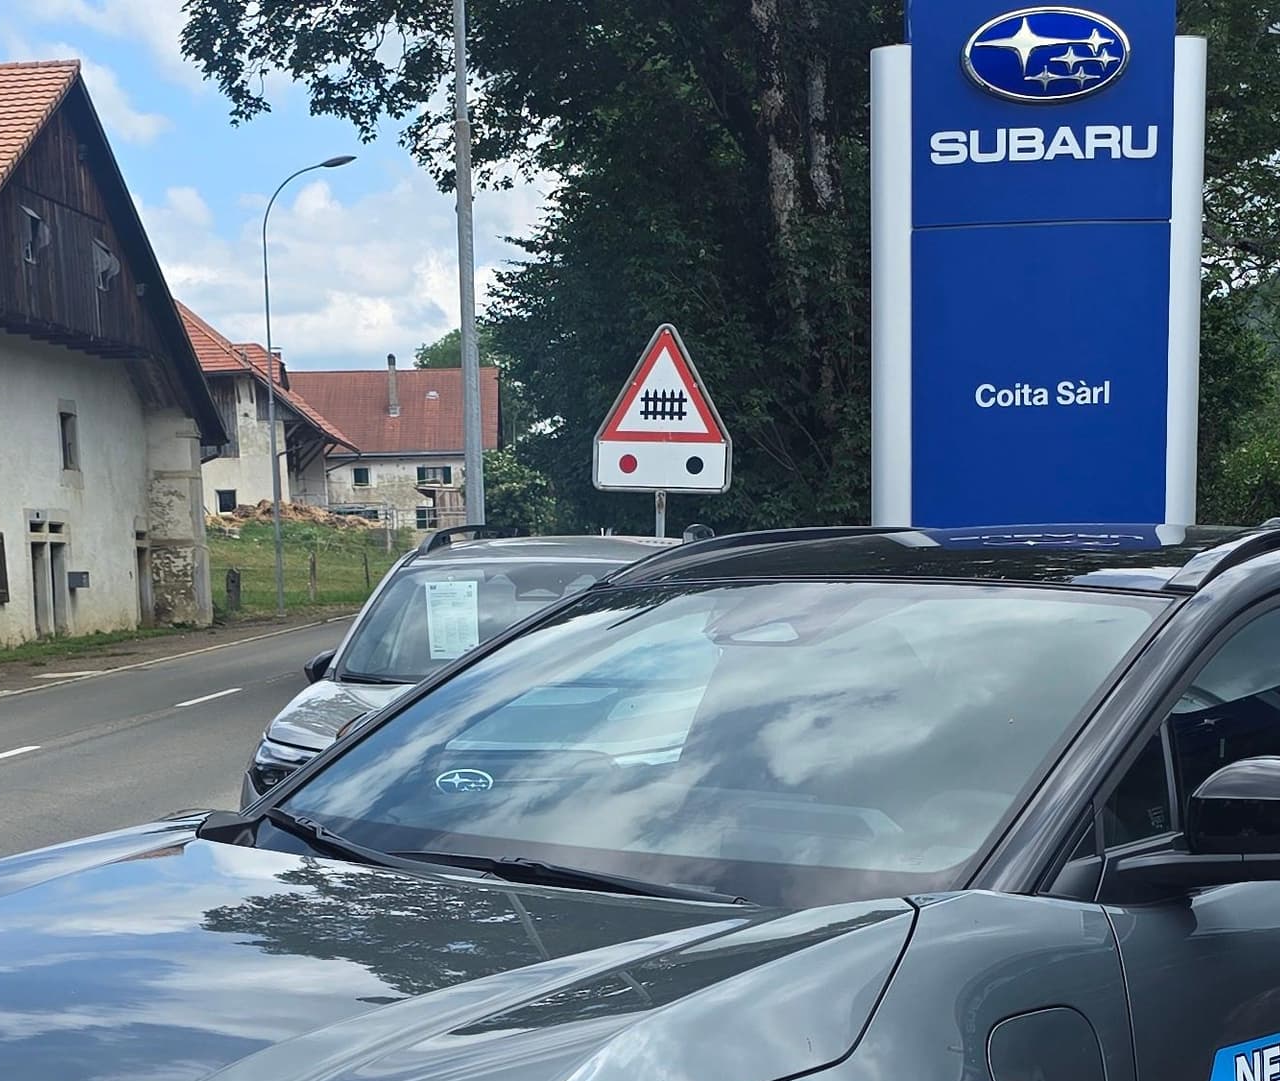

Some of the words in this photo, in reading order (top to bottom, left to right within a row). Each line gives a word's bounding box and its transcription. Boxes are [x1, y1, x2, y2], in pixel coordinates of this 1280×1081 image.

[930, 125, 1158, 165] SUBARU
[975, 382, 1049, 408] Coita
[1056, 380, 1111, 405] Sàrl
